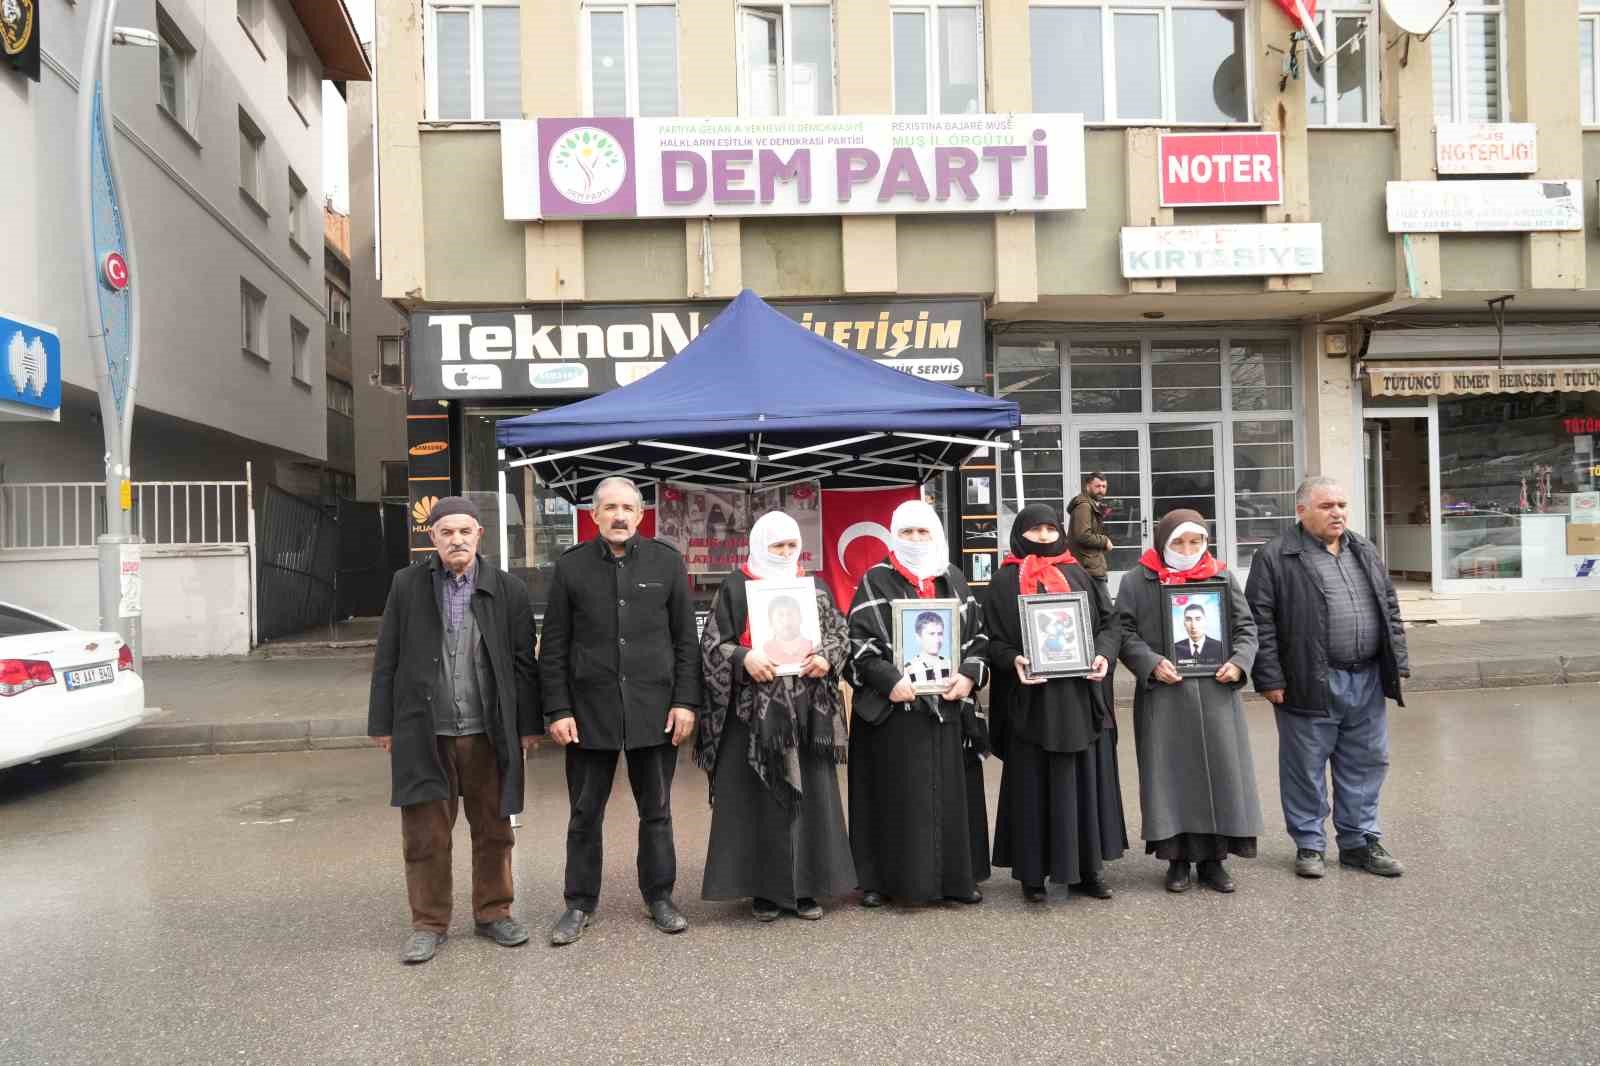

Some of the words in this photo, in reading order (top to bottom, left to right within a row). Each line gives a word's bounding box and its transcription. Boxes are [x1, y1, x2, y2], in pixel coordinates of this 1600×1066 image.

[755, 137, 768, 146] VE
[660, 149, 811, 205] DEM
[836, 129, 1048, 203] PARTİ
[1167, 154, 1273, 184] NOTER
[428, 312, 708, 361] TeknoN
[917, 363, 960, 375] SERVİS
